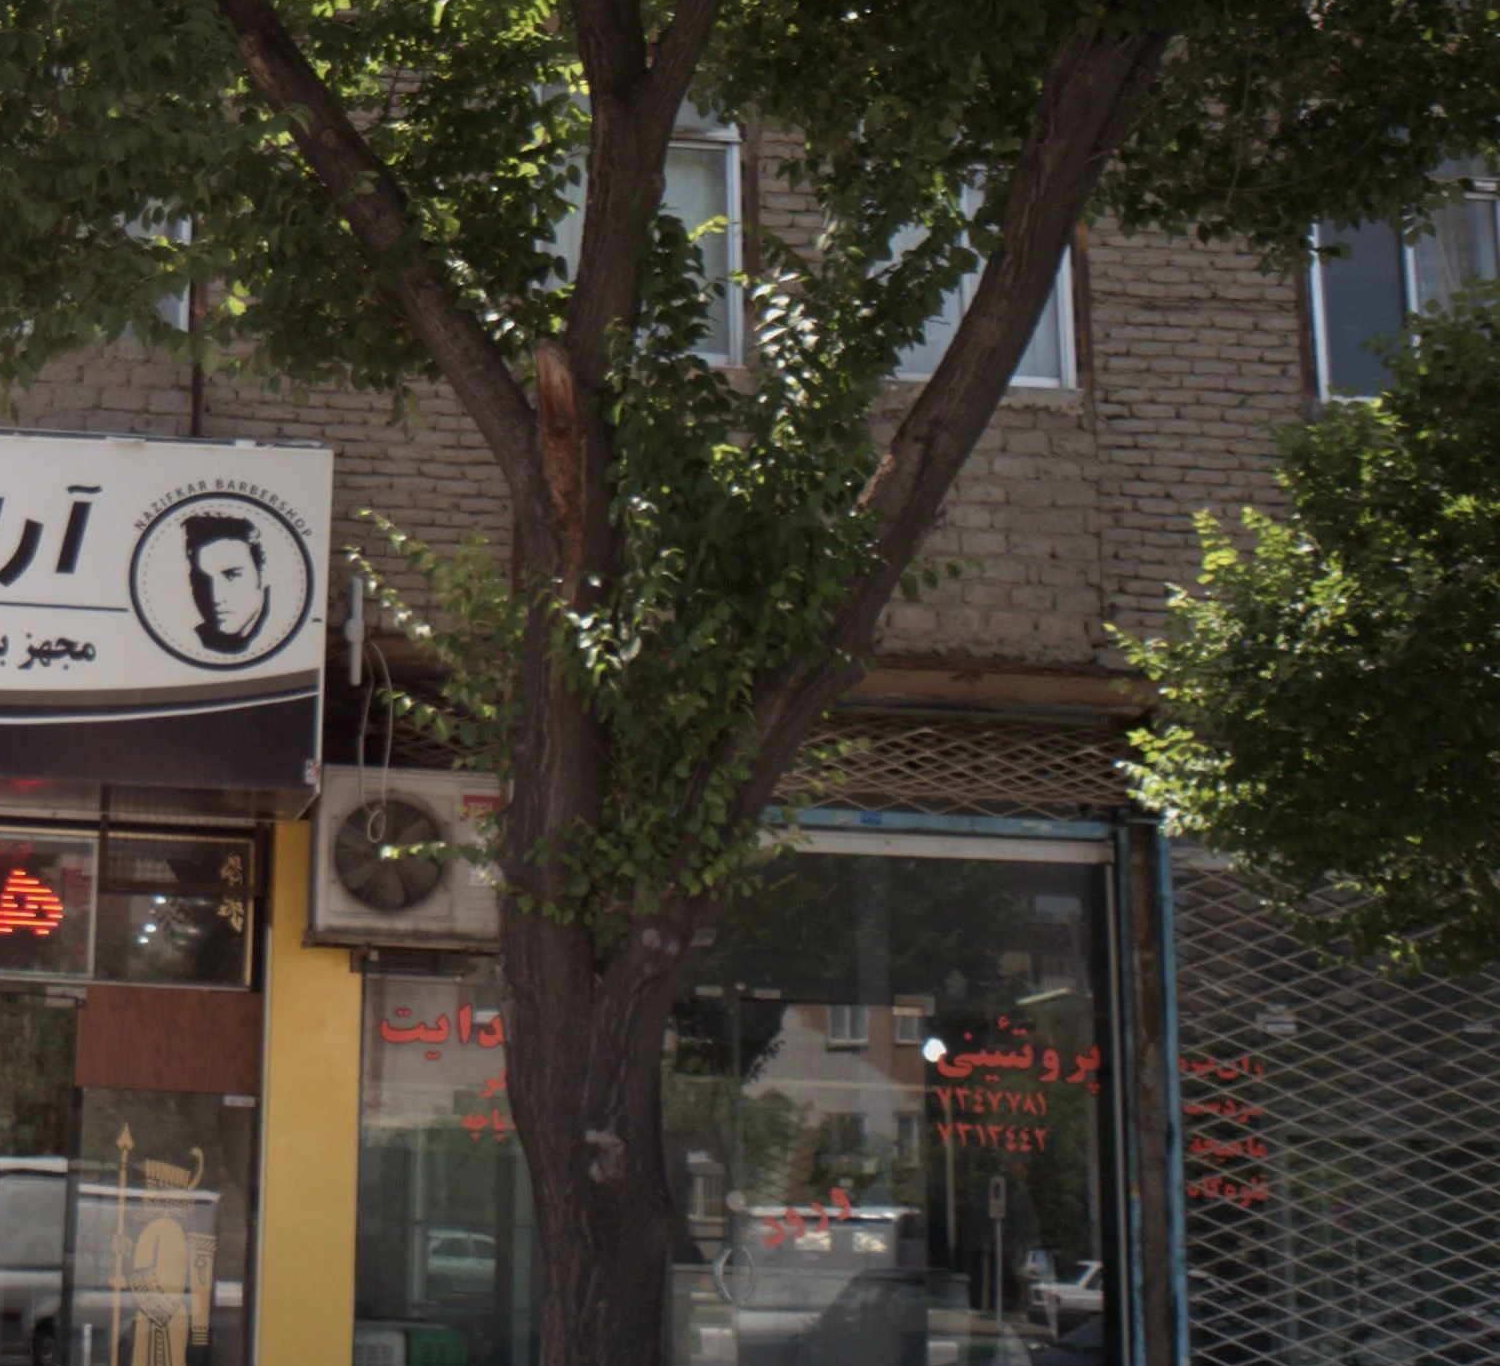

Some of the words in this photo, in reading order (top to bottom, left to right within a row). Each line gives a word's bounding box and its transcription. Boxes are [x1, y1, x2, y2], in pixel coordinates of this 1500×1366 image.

[134, 480, 208, 531] NAZIFKAR
[215, 479, 313, 538] BARBERSHOP
[17, 630, 98, 670] مجهز
[763, 1186, 852, 1249] ورود
